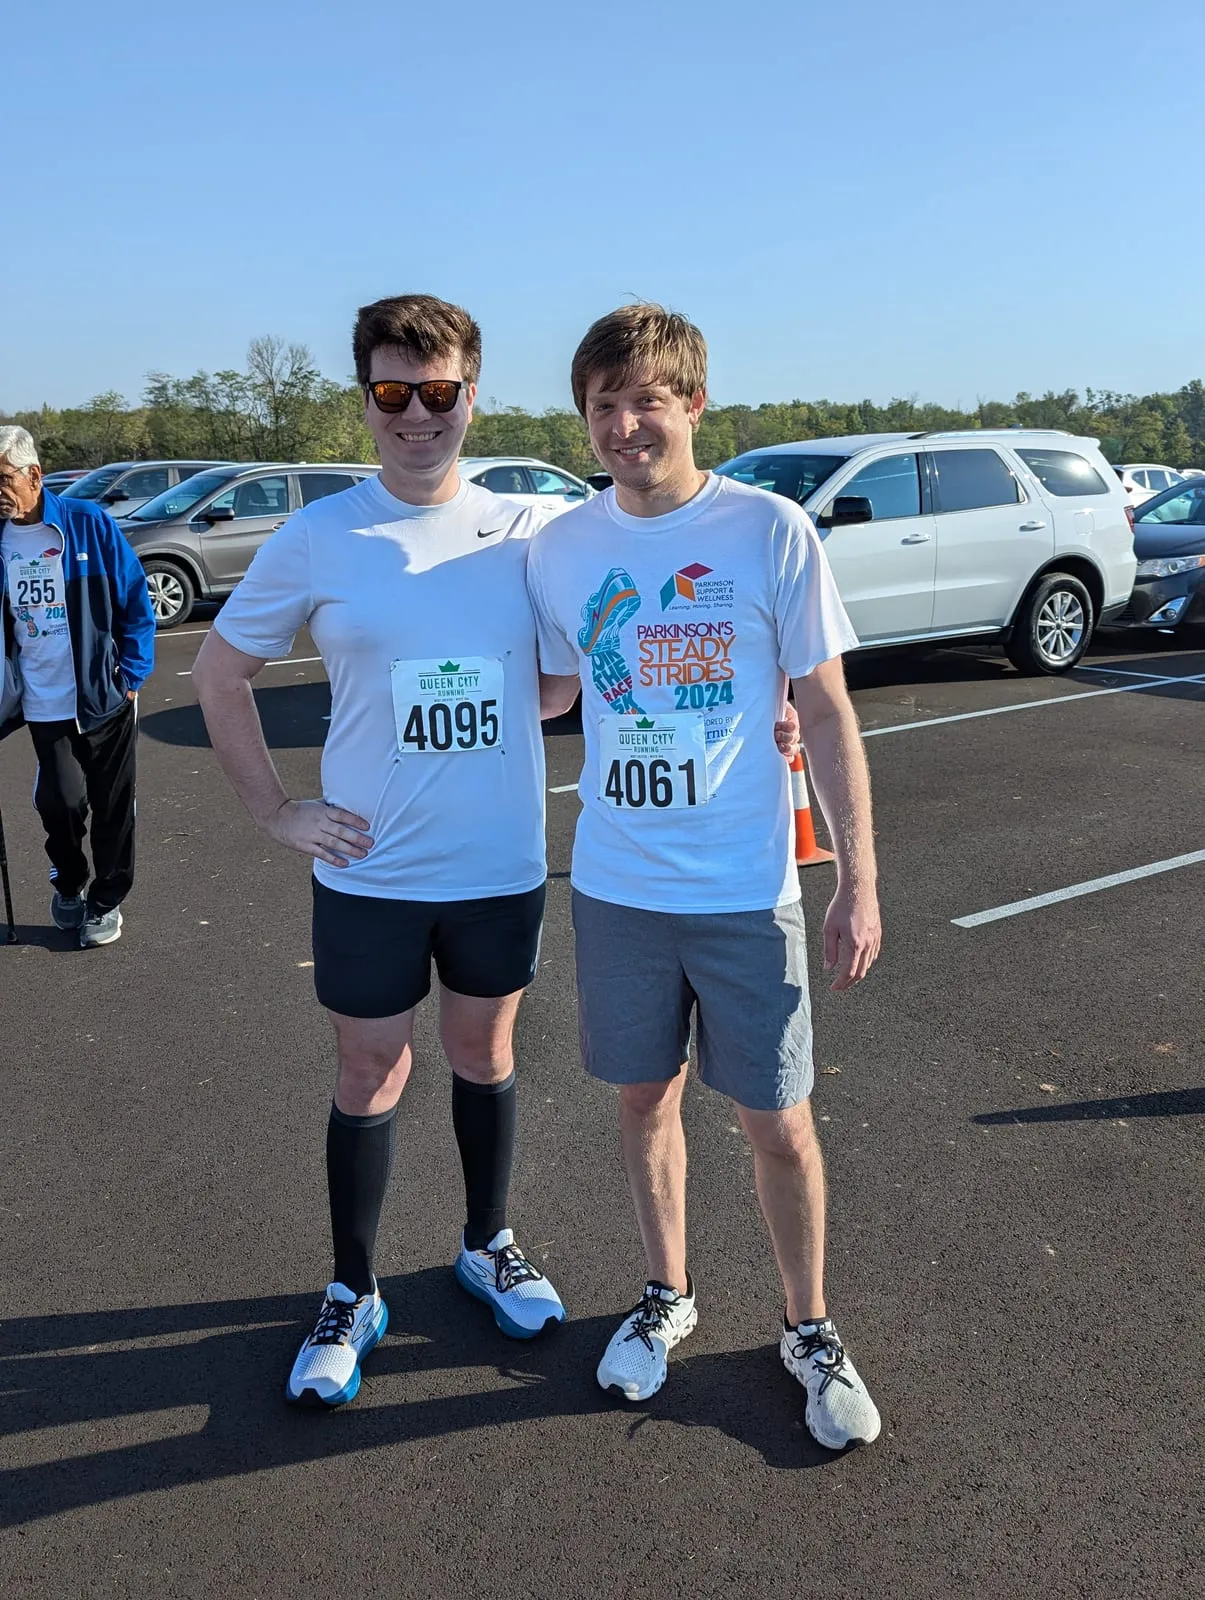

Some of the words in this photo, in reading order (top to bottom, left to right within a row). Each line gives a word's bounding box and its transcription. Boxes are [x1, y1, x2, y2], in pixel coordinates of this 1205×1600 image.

[17, 579, 55, 605] 255
[696, 587, 727, 595] SUPPORT
[697, 594, 734, 602] WELLNESS
[45, 606, 66, 619] 202
[637, 621, 734, 639] PARKINSON'S
[639, 635, 736, 664] STEADY
[420, 677, 453, 690] QUEEN
[458, 675, 479, 687] CITY
[593, 658, 632, 694] THE
[639, 657, 735, 686] STRIDES
[602, 675, 632, 704] RACE
[674, 680, 734, 710] 2024
[610, 690, 639, 715] 5K
[403, 699, 499, 751] 4095
[704, 717, 724, 726] ORED
[706, 728, 734, 739] rnus
[619, 733, 648, 745] QUEEN
[652, 732, 674, 745] CITY
[605, 759, 696, 808] 4061
